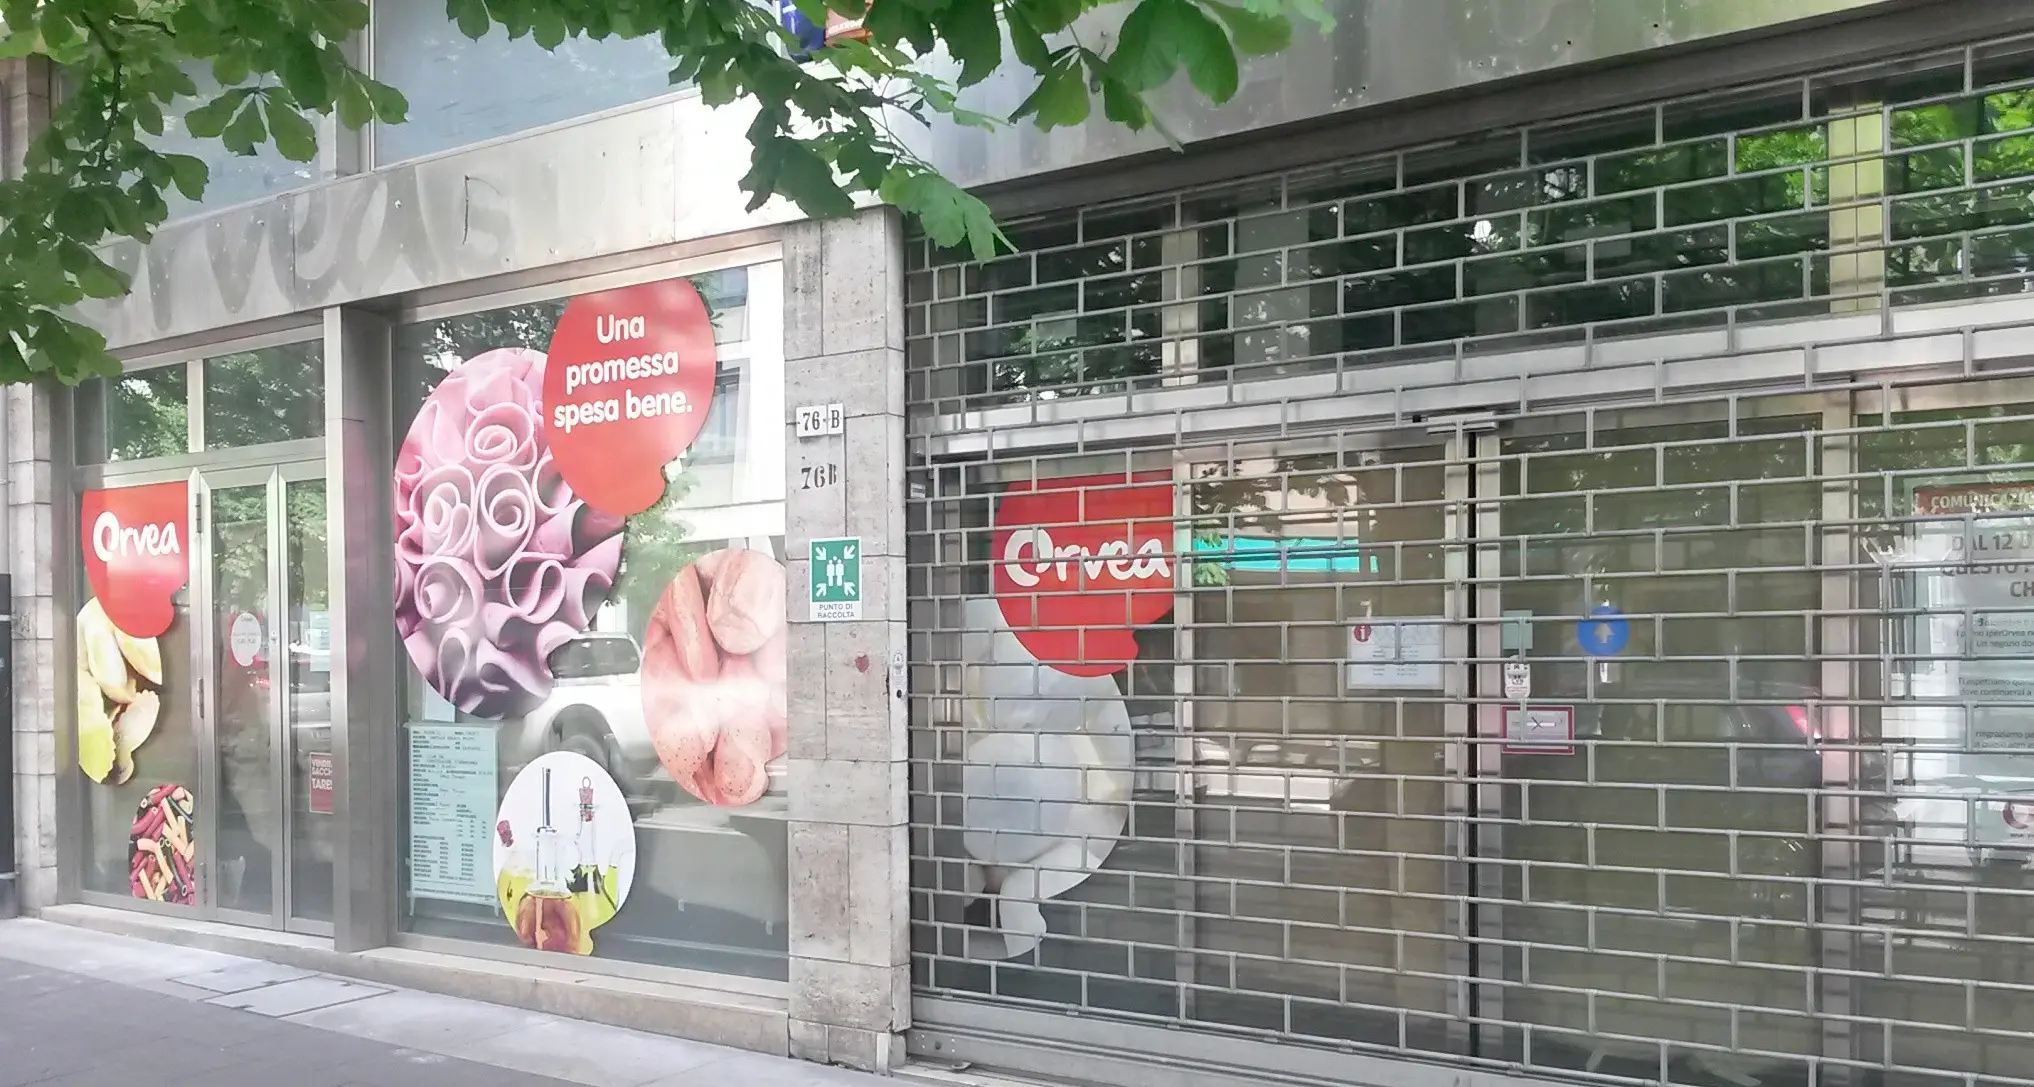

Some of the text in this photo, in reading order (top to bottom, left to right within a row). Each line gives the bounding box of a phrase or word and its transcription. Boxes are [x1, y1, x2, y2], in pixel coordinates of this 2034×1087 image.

[596, 313, 645, 344] Una
[566, 351, 679, 395] promessa
[553, 388, 693, 434] spesa bene.
[93, 511, 180, 562] Orvea
[1004, 528, 1171, 587] Orvea
[1992, 534, 2014, 550] 12
[817, 611, 855, 619] RACCOLTA
